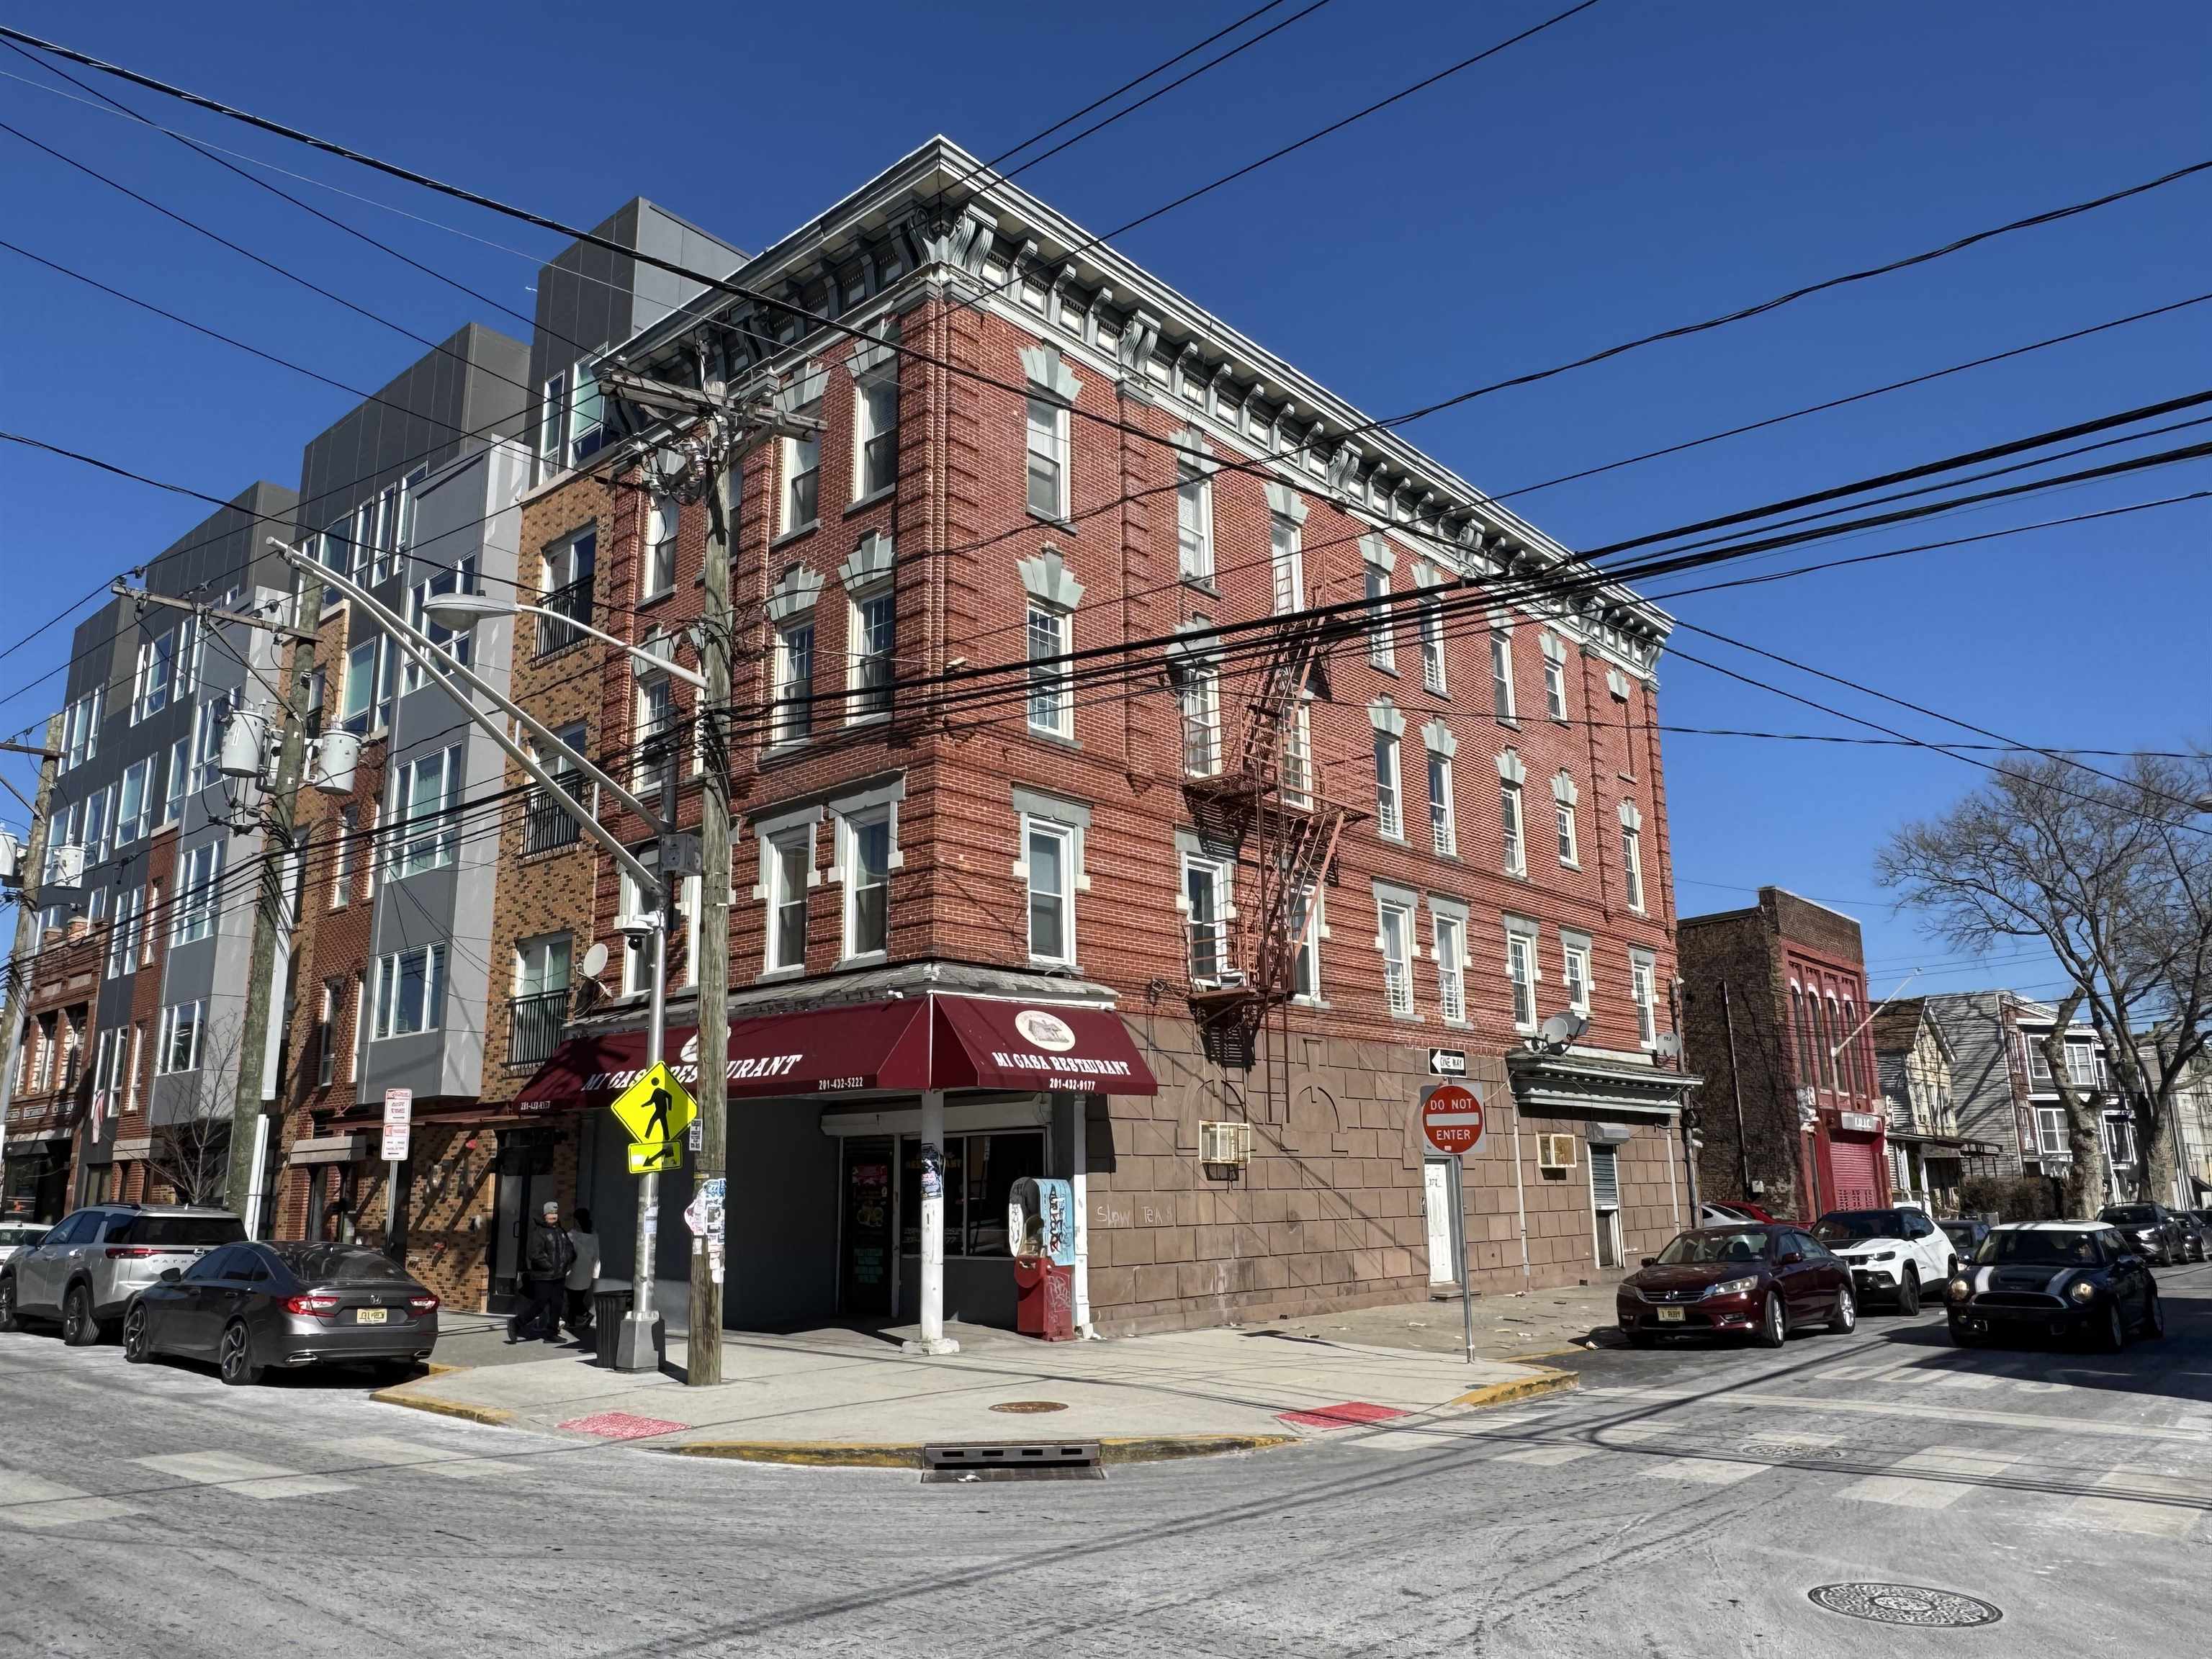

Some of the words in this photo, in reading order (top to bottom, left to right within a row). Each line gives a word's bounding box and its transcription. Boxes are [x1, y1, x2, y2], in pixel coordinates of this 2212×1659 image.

[580, 1071, 611, 1092] MI
[607, 1069, 648, 1089] CAS
[669, 1053, 803, 1084] RESURANT
[992, 1051, 1014, 1067] MI
[1012, 1053, 1051, 1070] CASA
[1049, 1056, 1131, 1076] RESTAURANT
[1430, 1100, 1445, 1110] DO
[1451, 1098, 1473, 1110] NOT
[1436, 1130, 1471, 1141] ENTER
